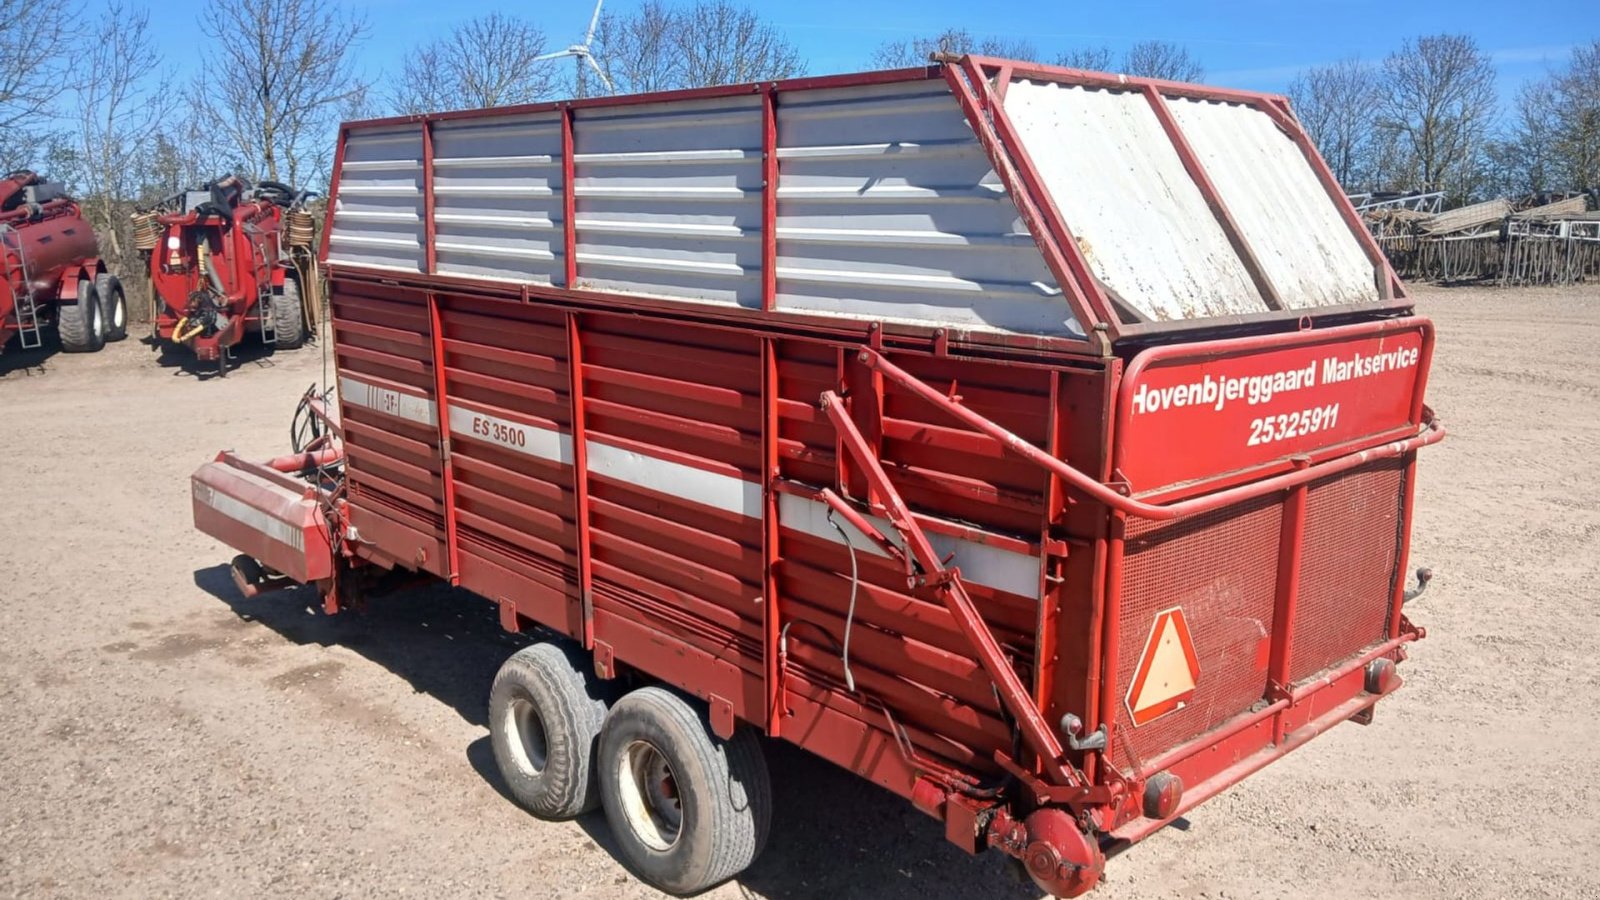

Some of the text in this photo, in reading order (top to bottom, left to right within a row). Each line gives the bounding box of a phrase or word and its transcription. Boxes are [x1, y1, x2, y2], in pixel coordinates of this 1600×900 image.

[1131, 346, 1418, 415] Hovenbjerggaard Markservice
[473, 417, 526, 447] ES 3500
[1247, 403, 1339, 446] 25325911
